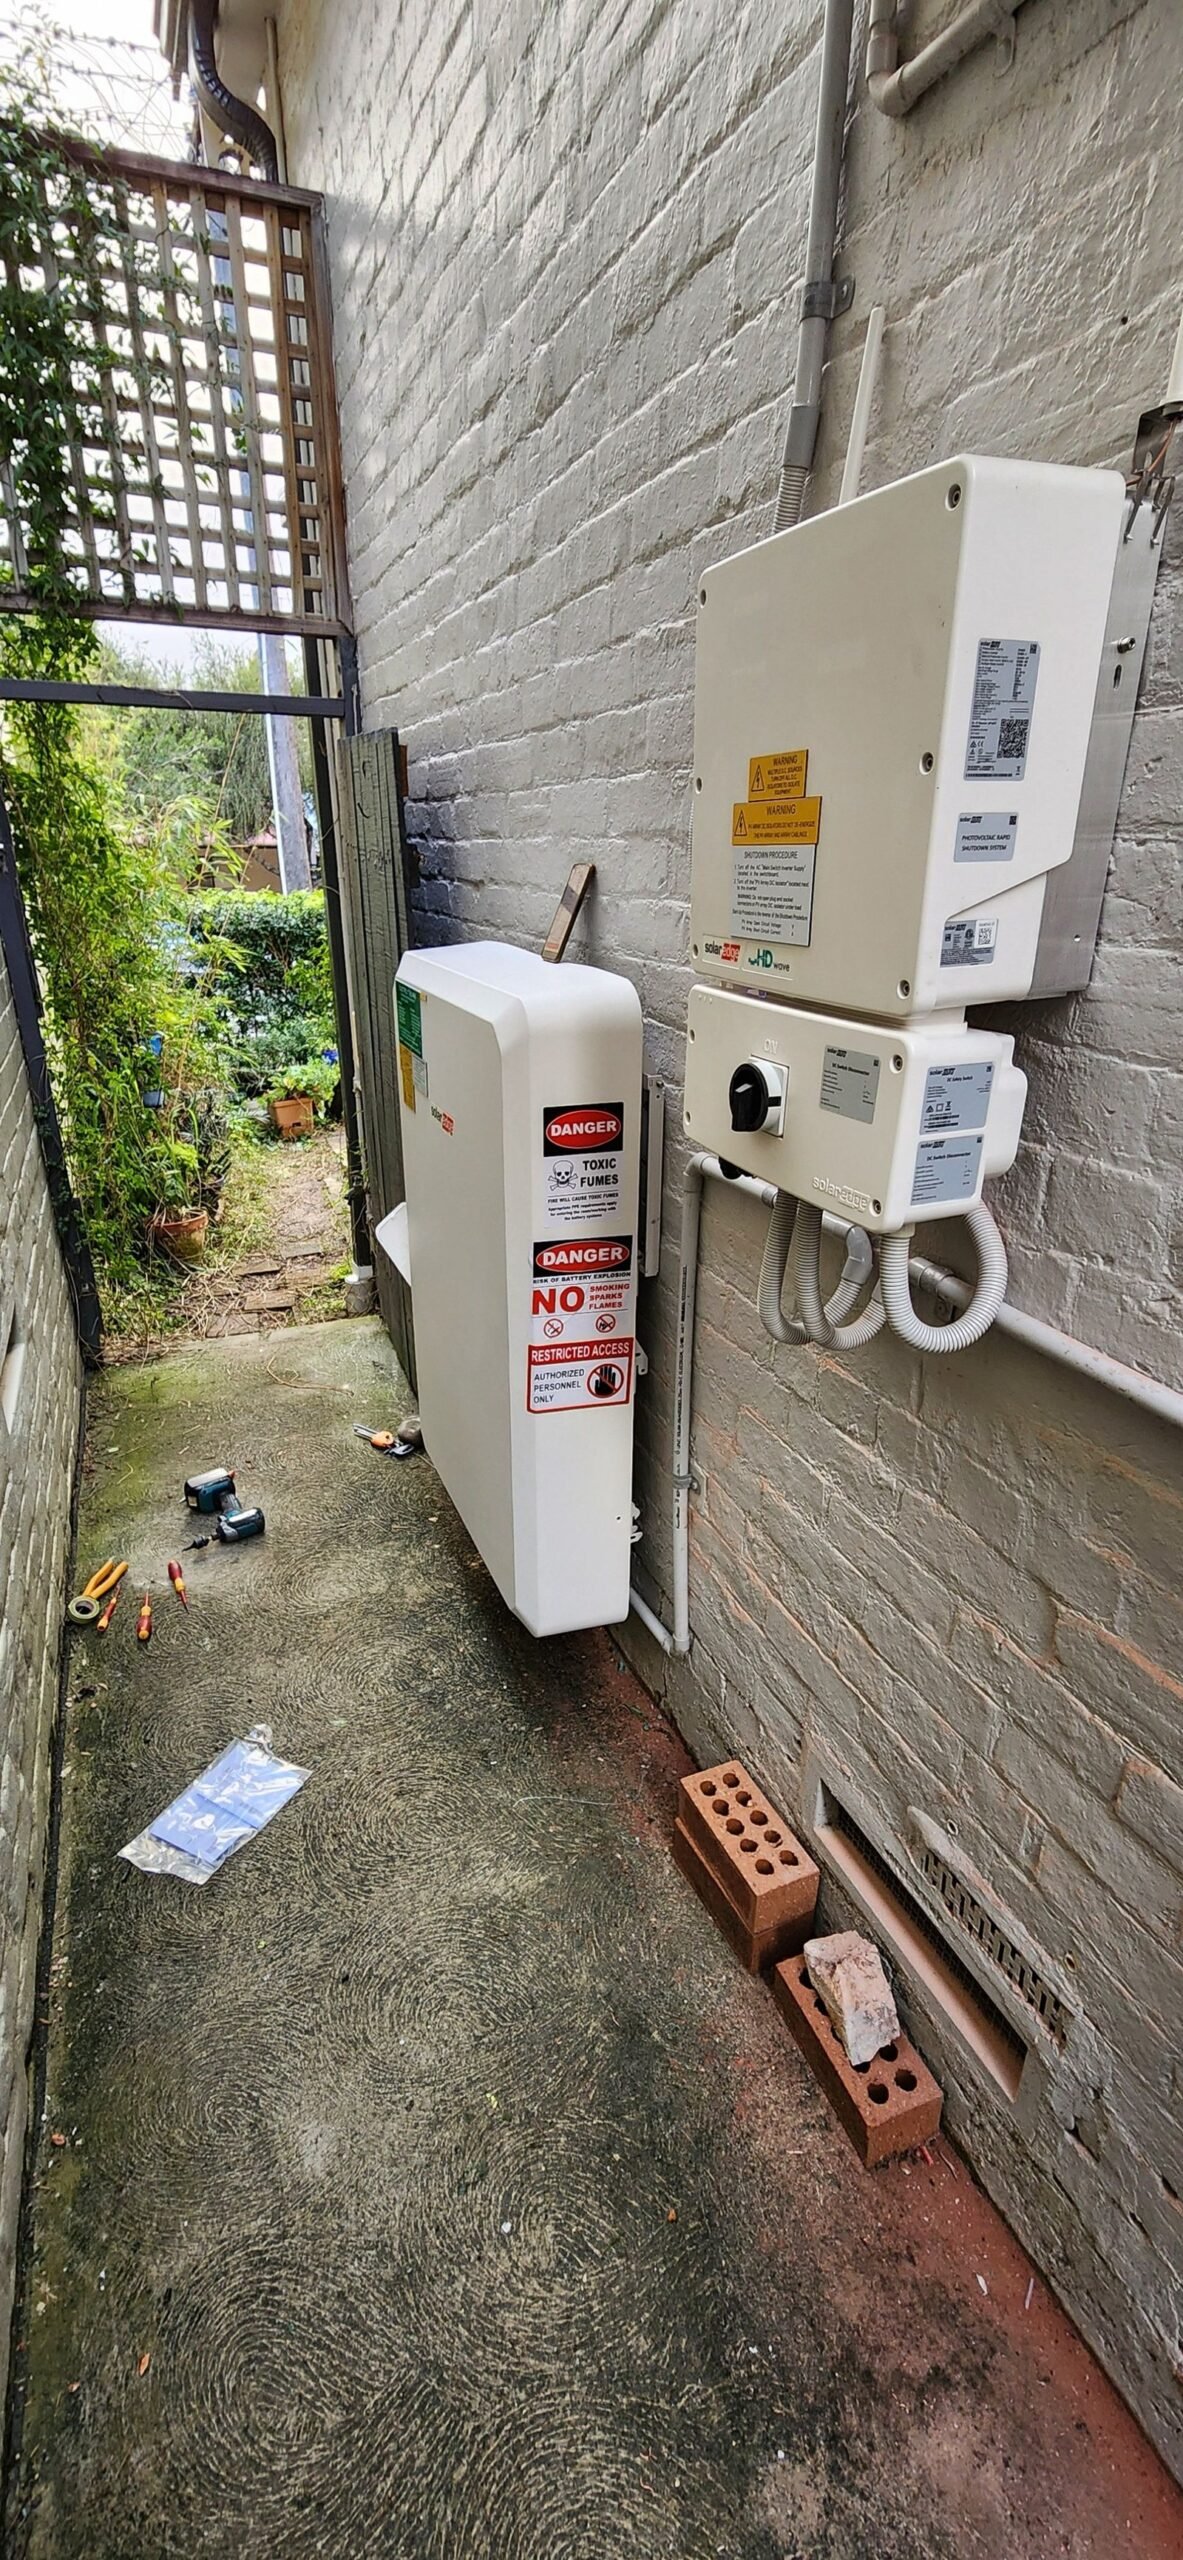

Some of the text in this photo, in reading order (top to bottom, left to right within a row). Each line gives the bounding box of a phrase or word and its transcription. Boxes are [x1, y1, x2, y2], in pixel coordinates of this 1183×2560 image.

[774, 755, 797, 766] WARNING
[767, 804, 796, 816] WARNING
[744, 851, 798, 859] SHUTDOWN PROCEDURE
[774, 963, 790, 972] wave
[551, 1120, 617, 1137] DANGER
[583, 1158, 617, 1171] TOXIC
[581, 1174, 619, 1187] FUMES
[543, 1247, 623, 1266] DANGER
[590, 1284, 630, 1292] SMOKING
[532, 1286, 585, 1315] NO
[590, 1293, 623, 1301] SPARKS
[589, 1302, 623, 1310] FLAMES
[532, 1342, 630, 1362] RESTRICTED ACCESS
[534, 1369, 585, 1381] AUTHORIZED
[534, 1381, 582, 1392] PERSONNEL
[534, 1395, 554, 1404] ONLY
